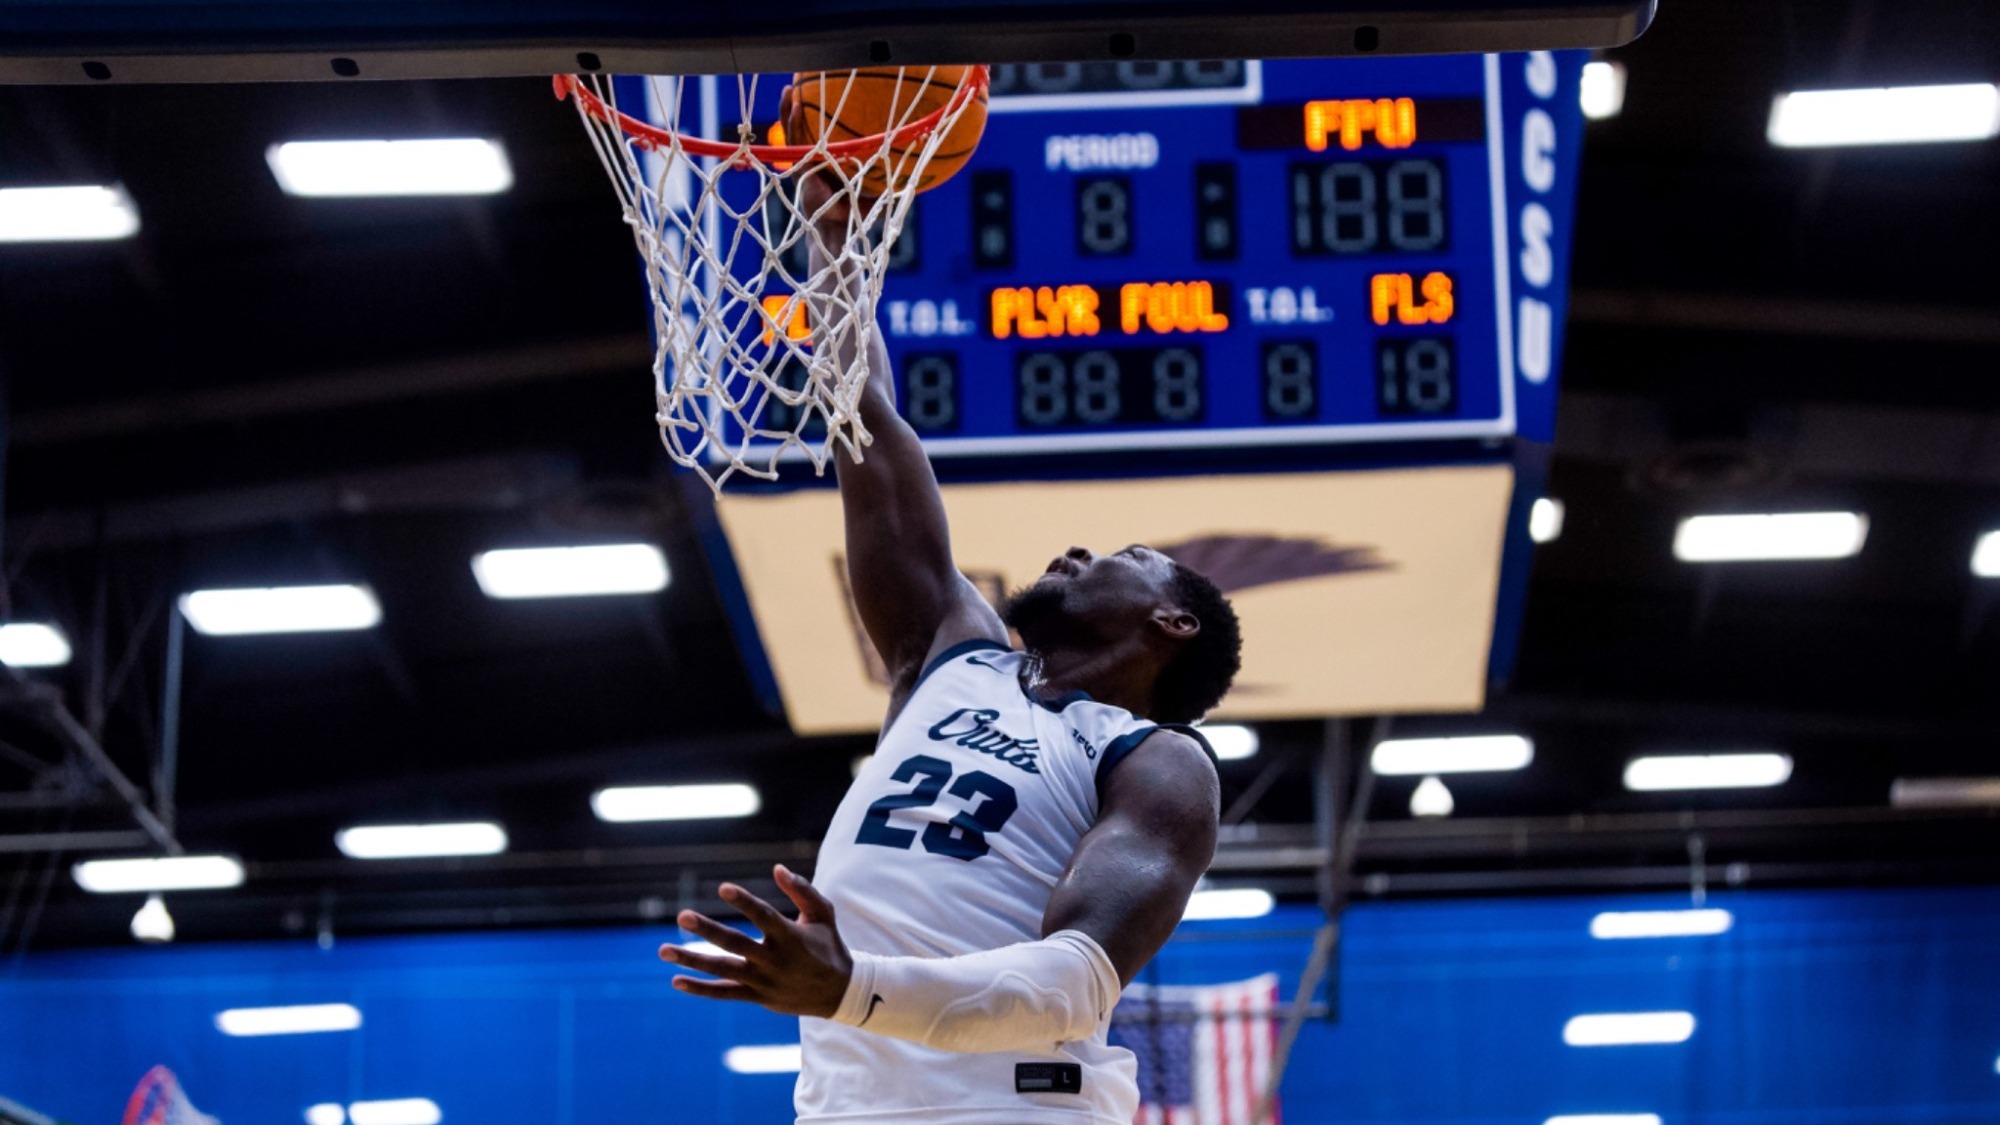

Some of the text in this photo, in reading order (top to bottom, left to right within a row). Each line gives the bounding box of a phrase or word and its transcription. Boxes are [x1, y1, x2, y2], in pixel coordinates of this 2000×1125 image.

[1045, 132, 1160, 170] PERIOD
[1305, 98, 1416, 151] FPU
[763, 295, 814, 347] FL
[991, 280, 1229, 340] PLYR FOUL
[1370, 271, 1454, 325] FLS
[854, 754, 1018, 862] 23
